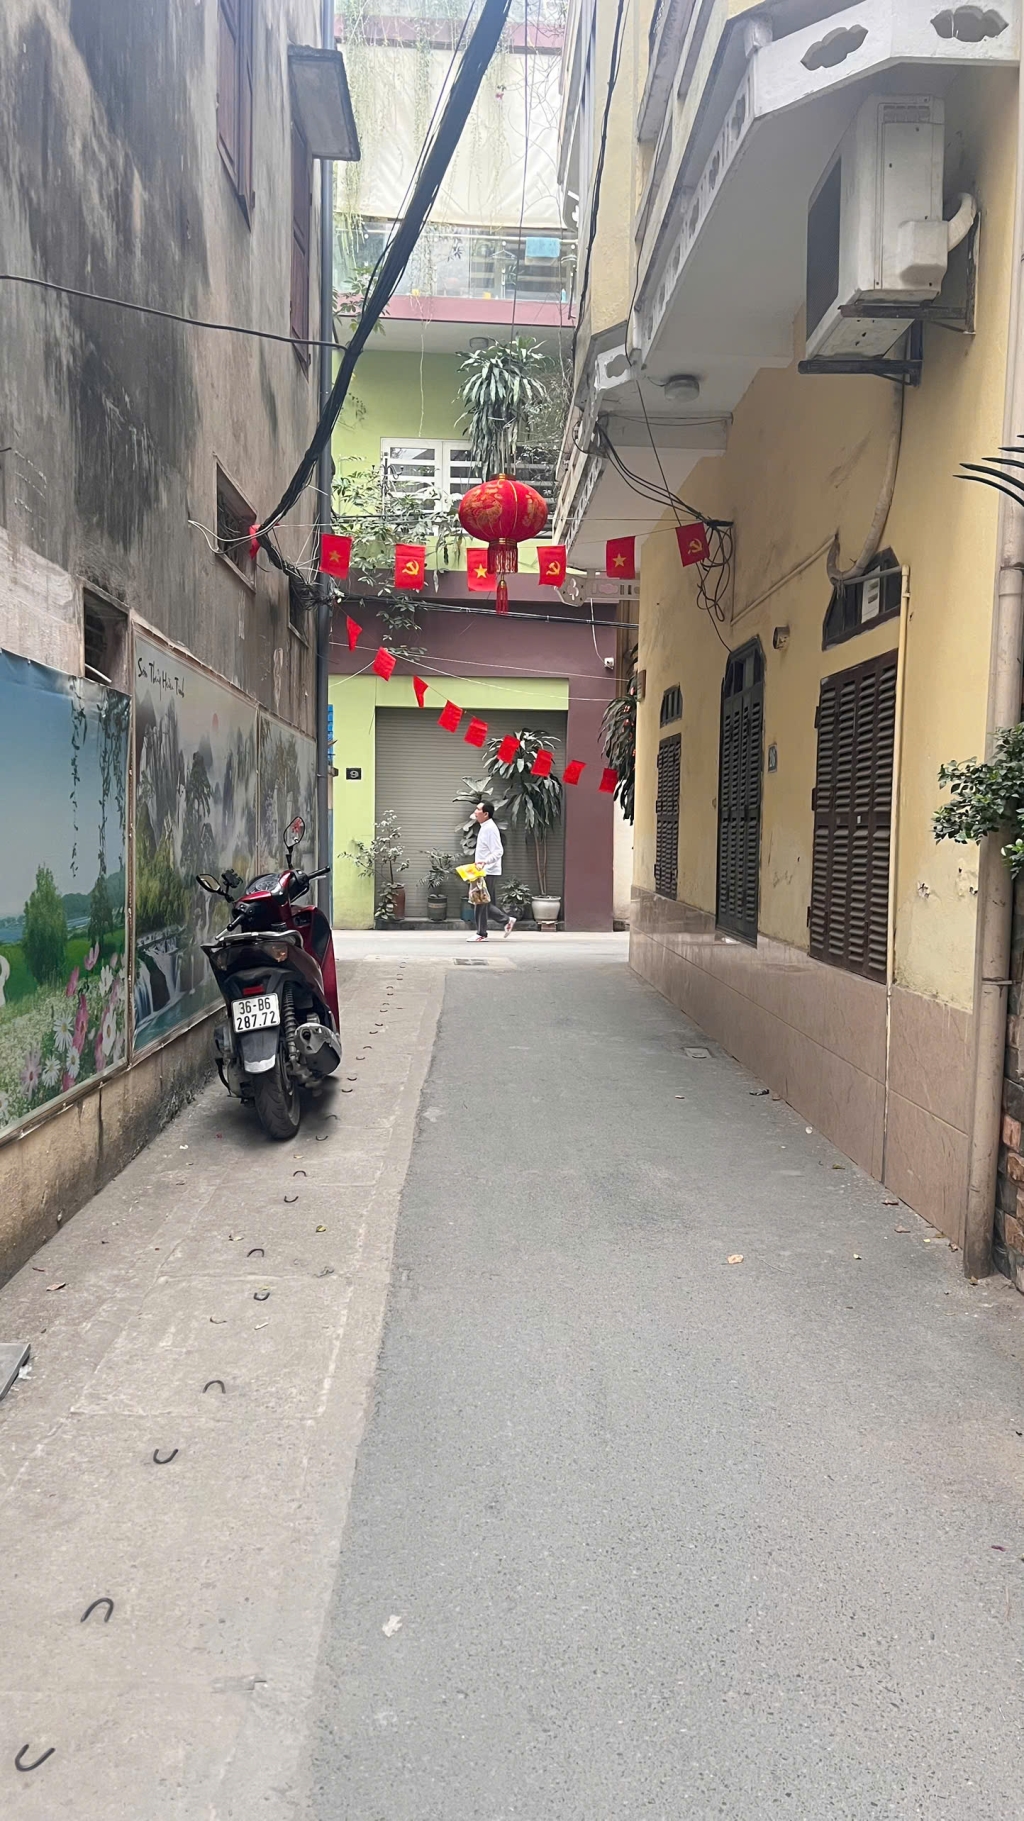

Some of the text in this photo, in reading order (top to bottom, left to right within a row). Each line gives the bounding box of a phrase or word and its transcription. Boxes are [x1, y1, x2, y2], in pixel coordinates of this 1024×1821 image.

[349, 770, 359, 779] 9
[238, 997, 271, 1015] 36-B6
[236, 1010, 277, 1031] 287.72
